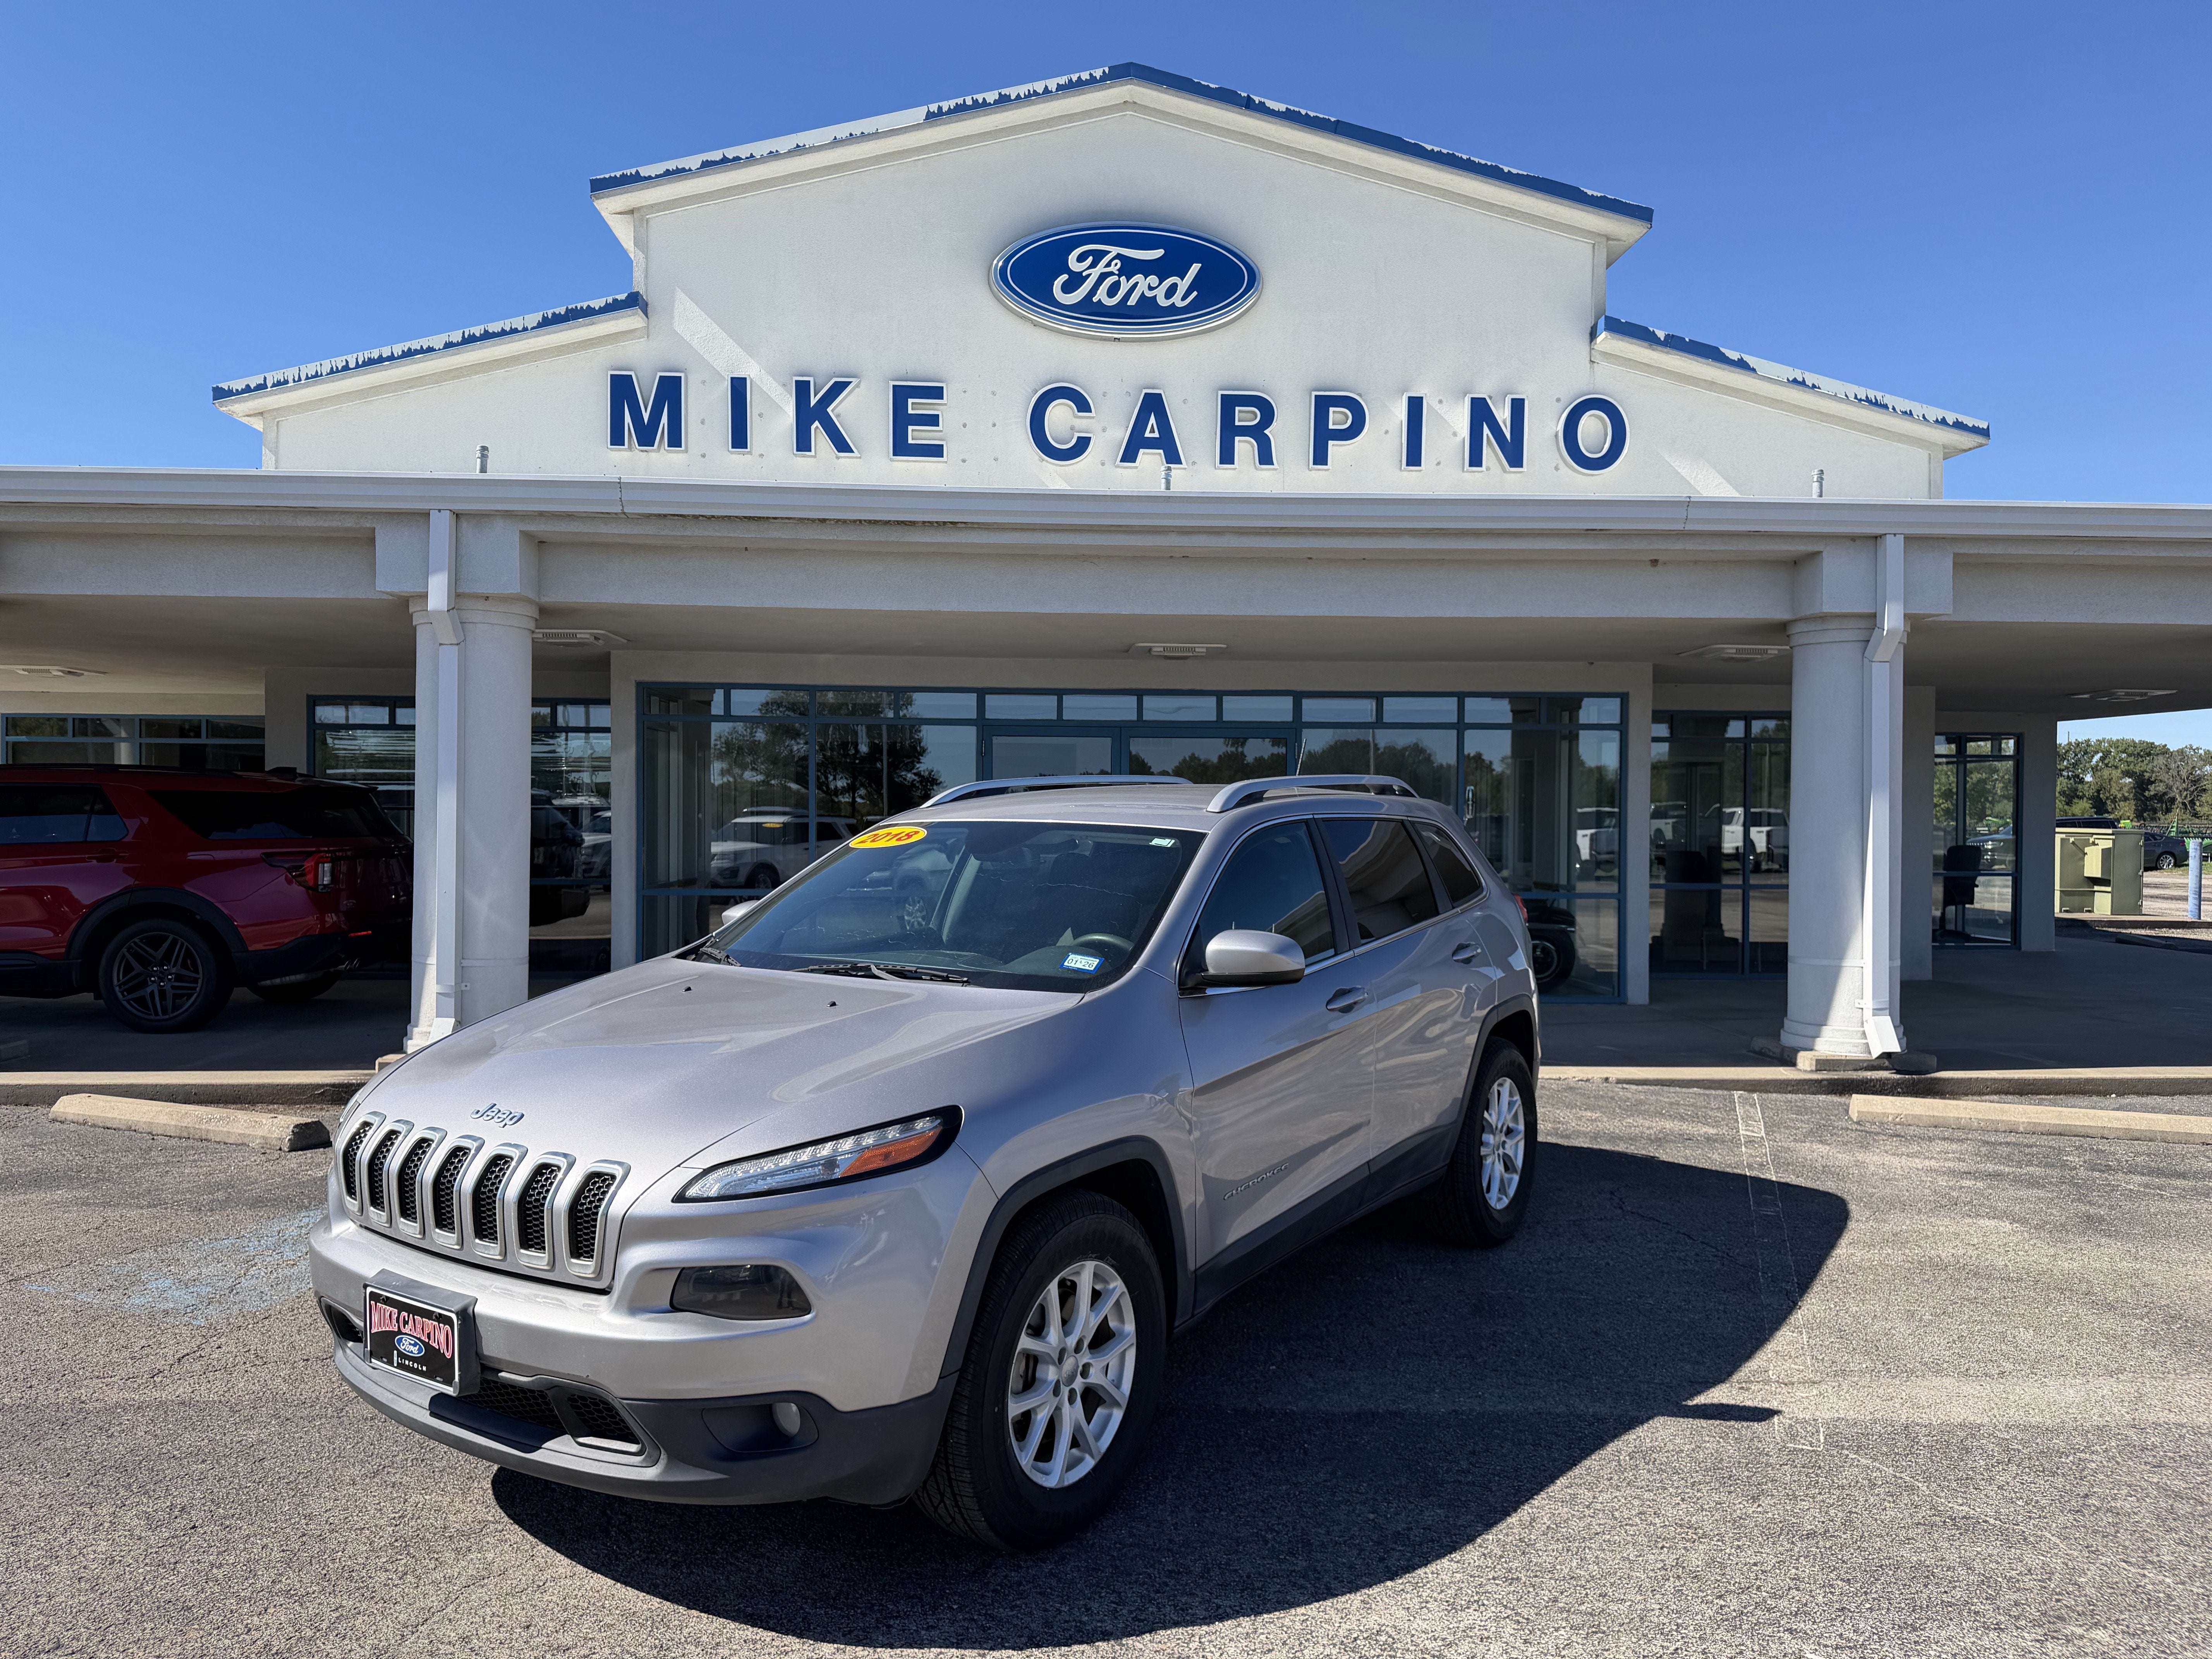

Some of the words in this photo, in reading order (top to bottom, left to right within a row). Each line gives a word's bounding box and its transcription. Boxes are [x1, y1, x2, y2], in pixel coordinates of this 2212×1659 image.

[1053, 244, 1202, 307] Ford
[607, 370, 948, 461] MIKE
[1026, 382, 1630, 475] CARPINO
[854, 830, 921, 845] 2018
[470, 1103, 525, 1128] Jeep
[371, 1301, 398, 1333] MIKE
[399, 1312, 452, 1358] CARPINO
[400, 1338, 419, 1354] Ford
[398, 1357, 426, 1371] LINCOLN
